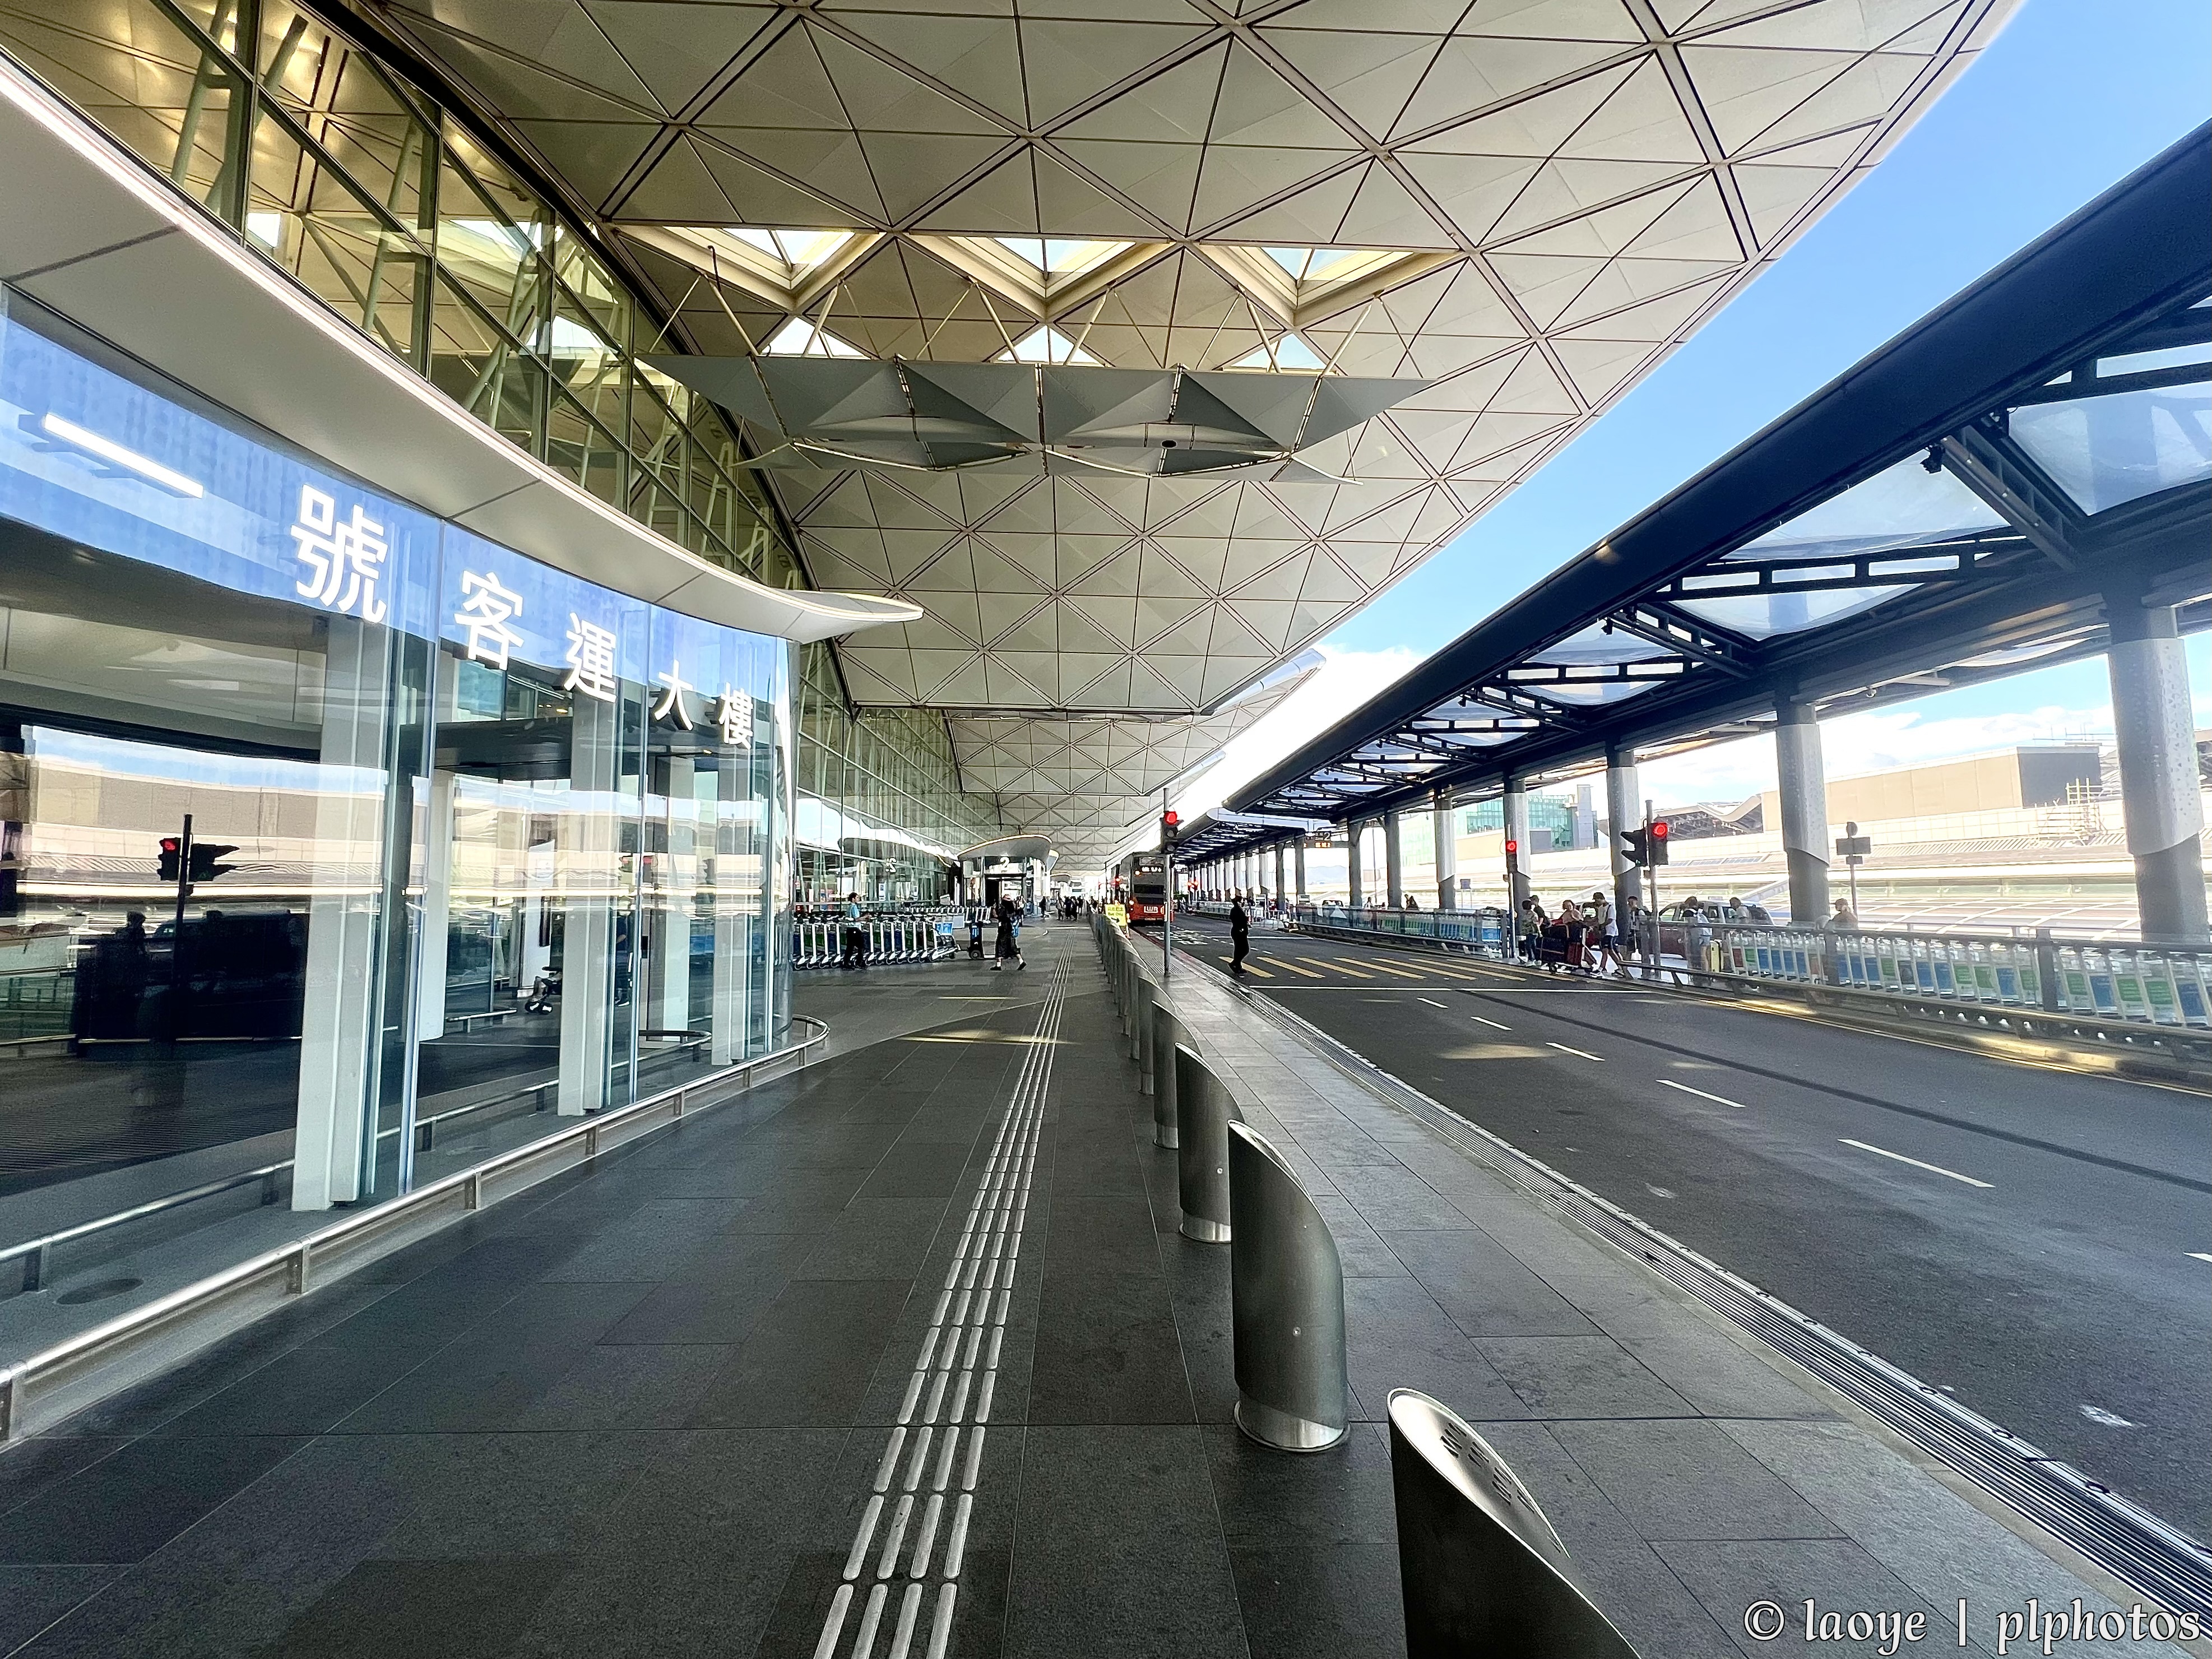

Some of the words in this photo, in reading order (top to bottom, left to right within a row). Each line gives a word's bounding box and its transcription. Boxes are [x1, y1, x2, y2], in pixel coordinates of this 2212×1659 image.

[44, 413, 754, 750] 一號客運大樓
[1324, 832, 1330, 841] 2
[999, 856, 1010, 871] 2
